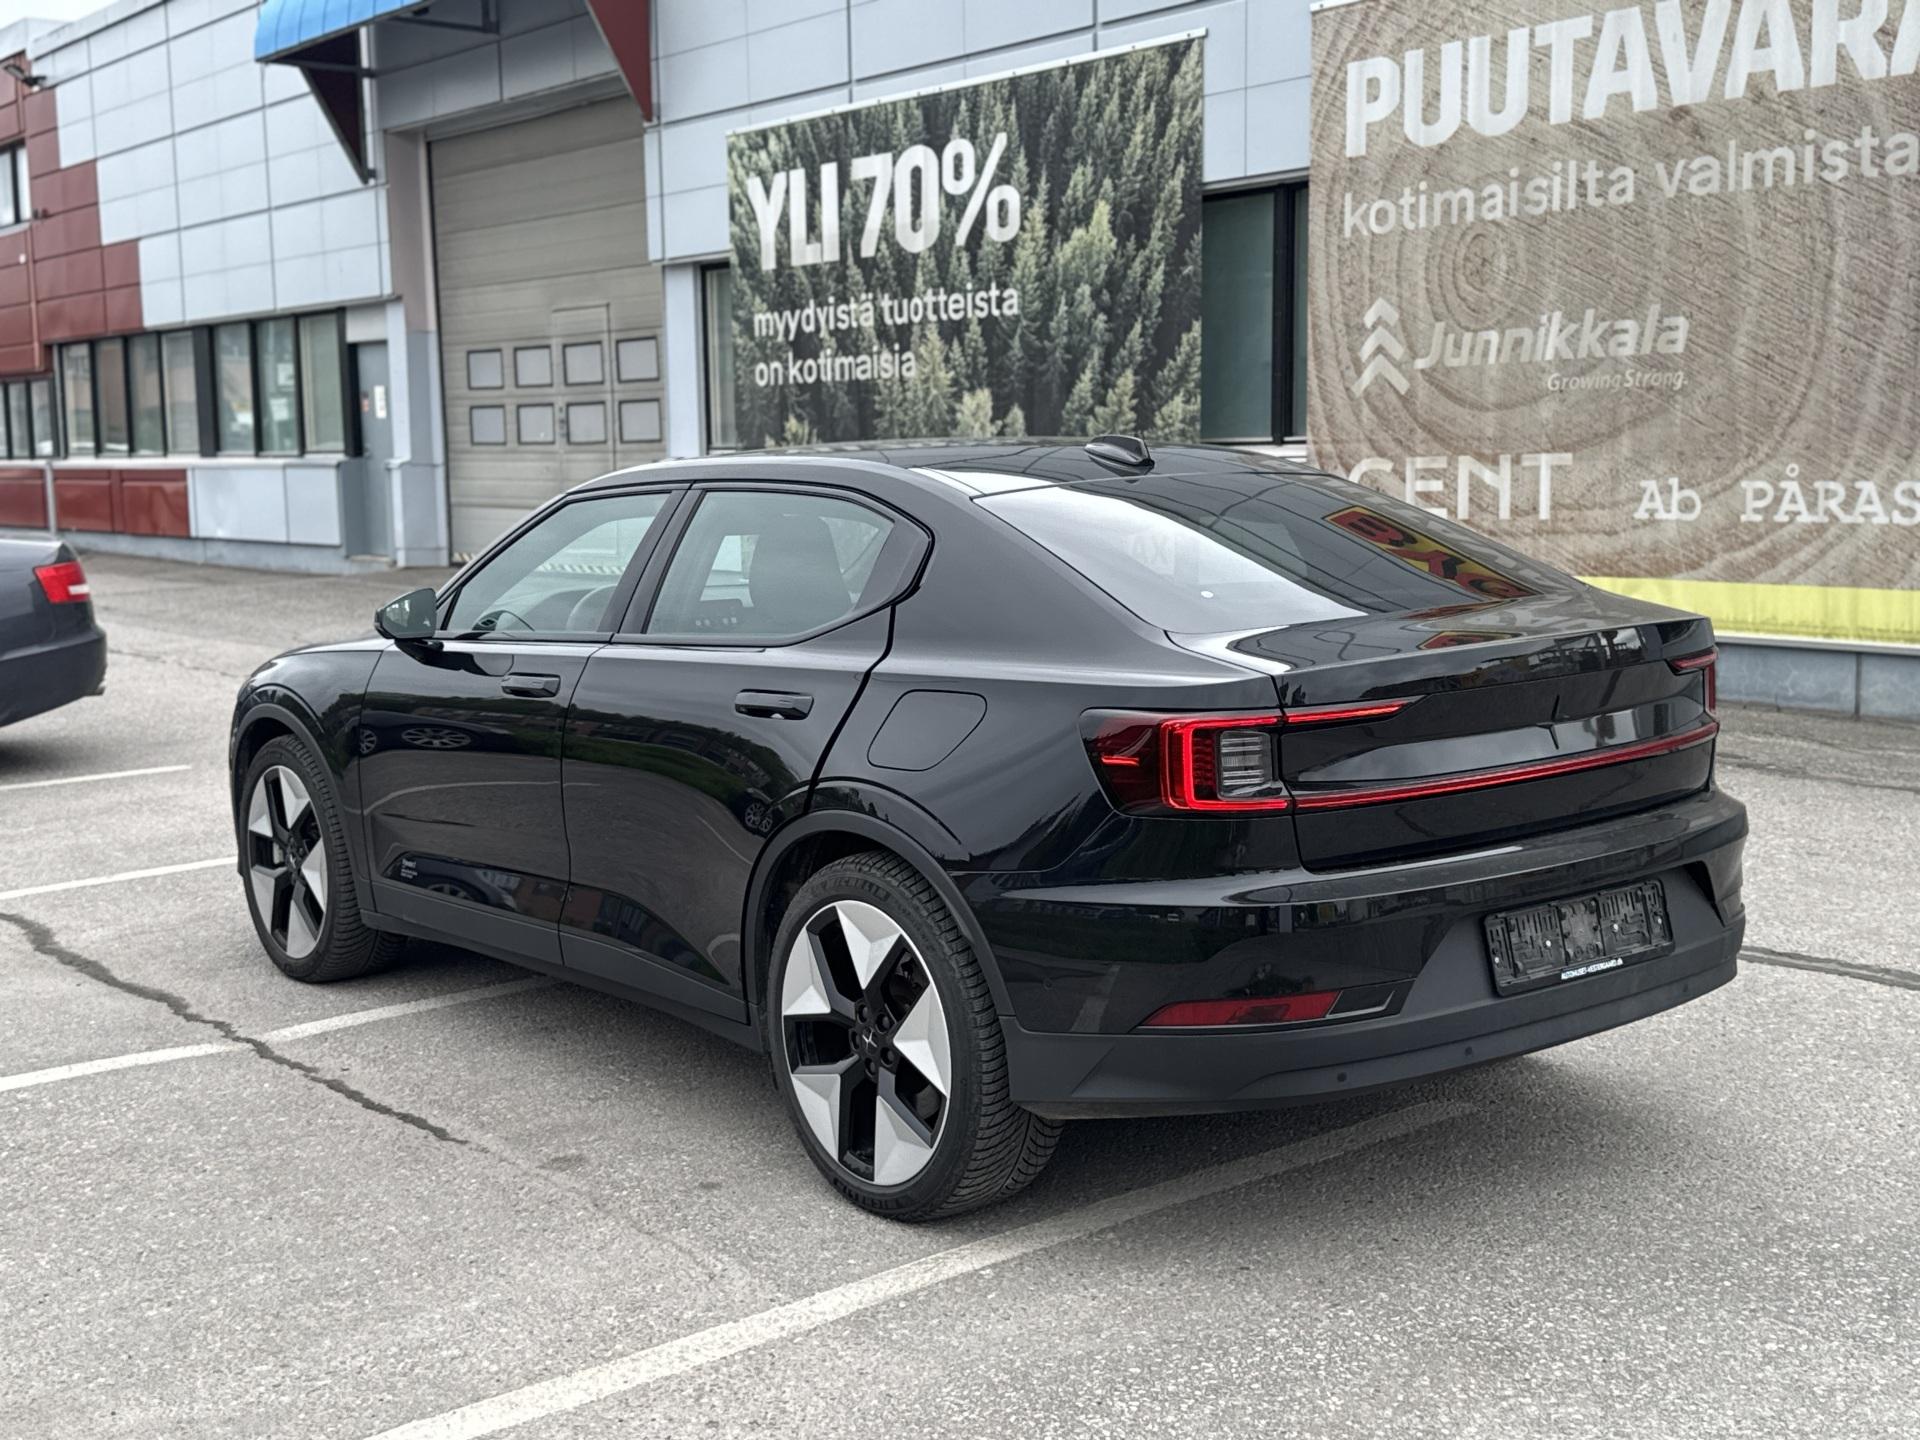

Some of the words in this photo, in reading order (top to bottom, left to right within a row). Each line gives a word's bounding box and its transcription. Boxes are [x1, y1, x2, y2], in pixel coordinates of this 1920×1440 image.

[747, 162, 840, 271] YLI
[851, 132, 1021, 258] 70%
[1344, 160, 1635, 238] kotimaisilta
[1654, 125, 1919, 198] valmista
[754, 293, 875, 342] myydyistä
[881, 282, 1019, 326] tuotteista
[1413, 304, 1690, 369] Junnikkala
[755, 360, 783, 387] on
[788, 343, 917, 385] kotimaisia
[1547, 372, 1621, 392] Growing
[1633, 477, 1702, 521] Ab
[1740, 463, 1920, 526] PÅRAS
